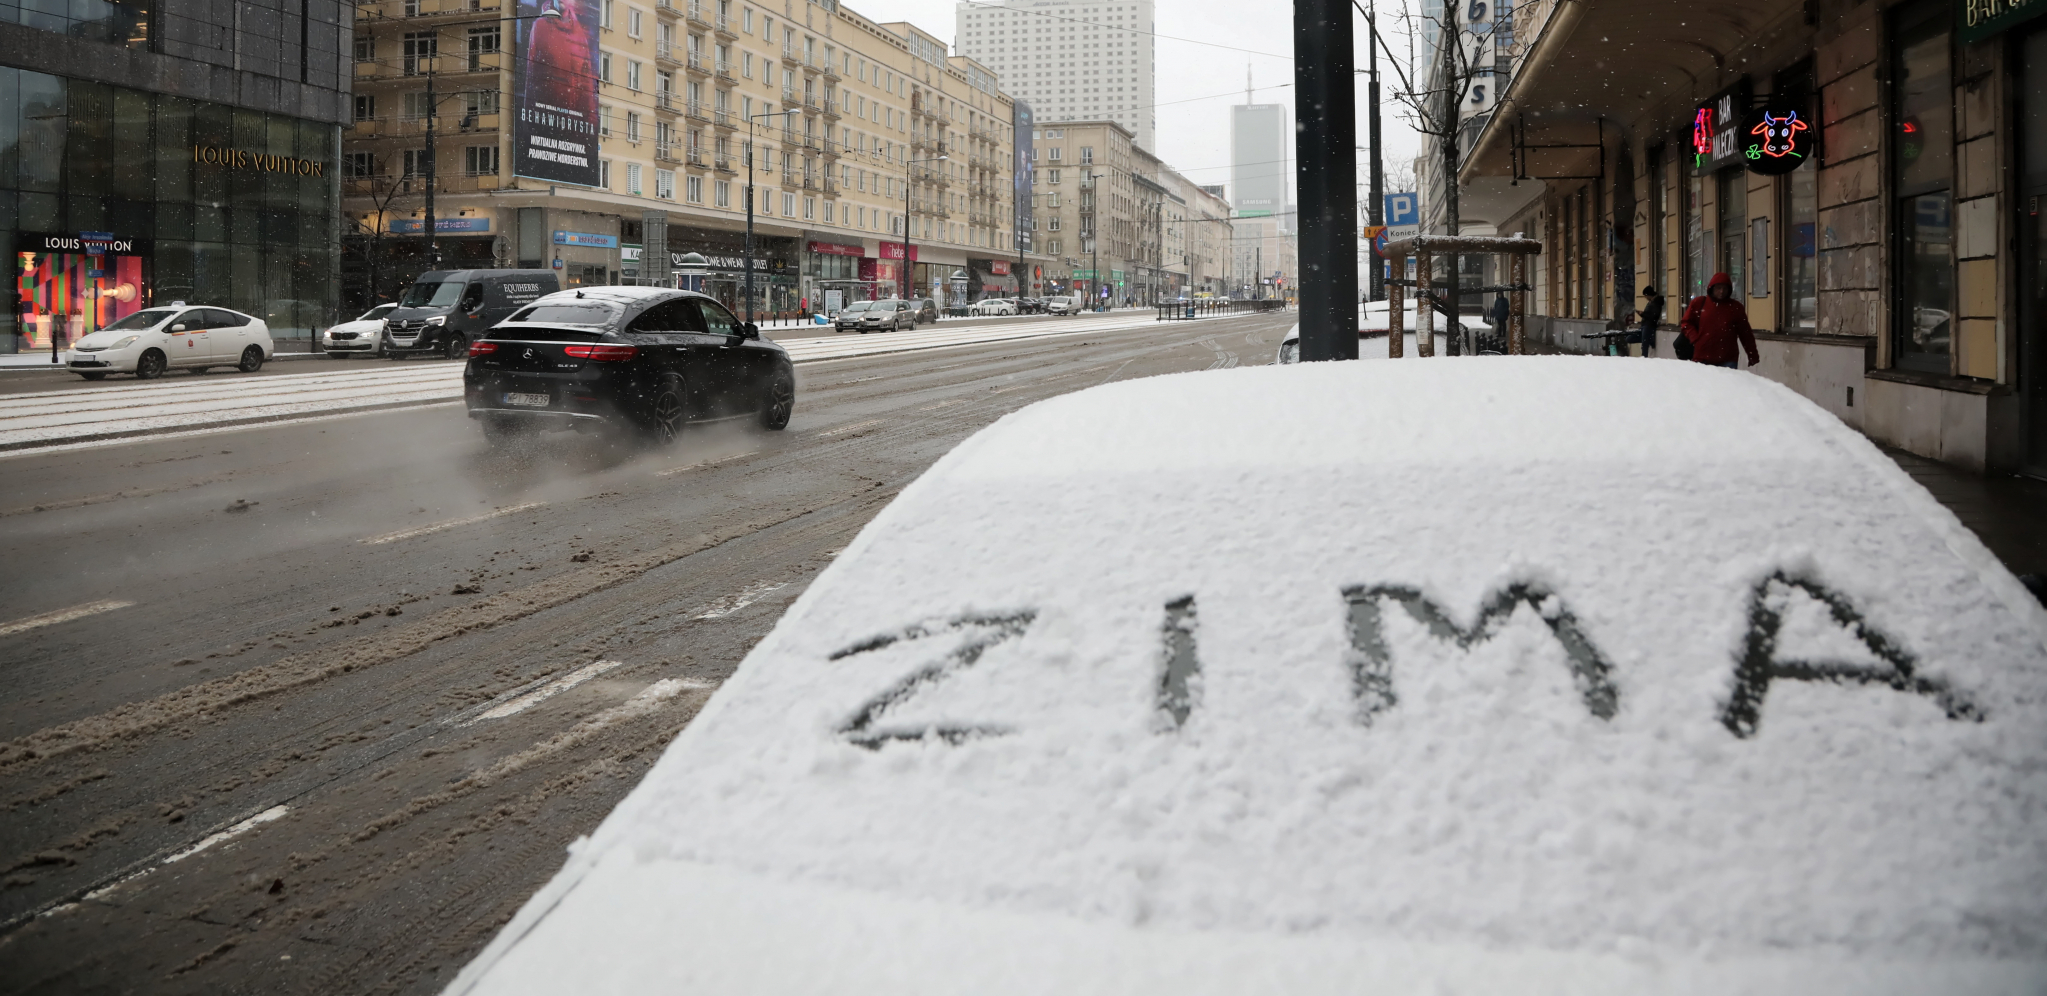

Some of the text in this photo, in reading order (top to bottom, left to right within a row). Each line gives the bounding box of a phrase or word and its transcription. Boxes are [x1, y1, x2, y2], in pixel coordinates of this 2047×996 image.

[1718, 94, 1732, 126] BAR
[521, 108, 595, 135] BEHAWIORYSTA
[530, 134, 558, 149] WIRTUALNA
[194, 144, 323, 178] LOUIS VUITTON
[528, 148, 558, 162] PRAWDZIWE
[1392, 196, 1412, 222] P
[1390, 229, 1416, 237] Koniec
[45, 237, 80, 249] LOUIS
[891, 244, 905, 259] hebe
[726, 257, 745, 268] WEAR
[503, 283, 540, 294] EQUIHERBS
[523, 394, 549, 404] 78839
[829, 570, 1986, 748] ZIMA
